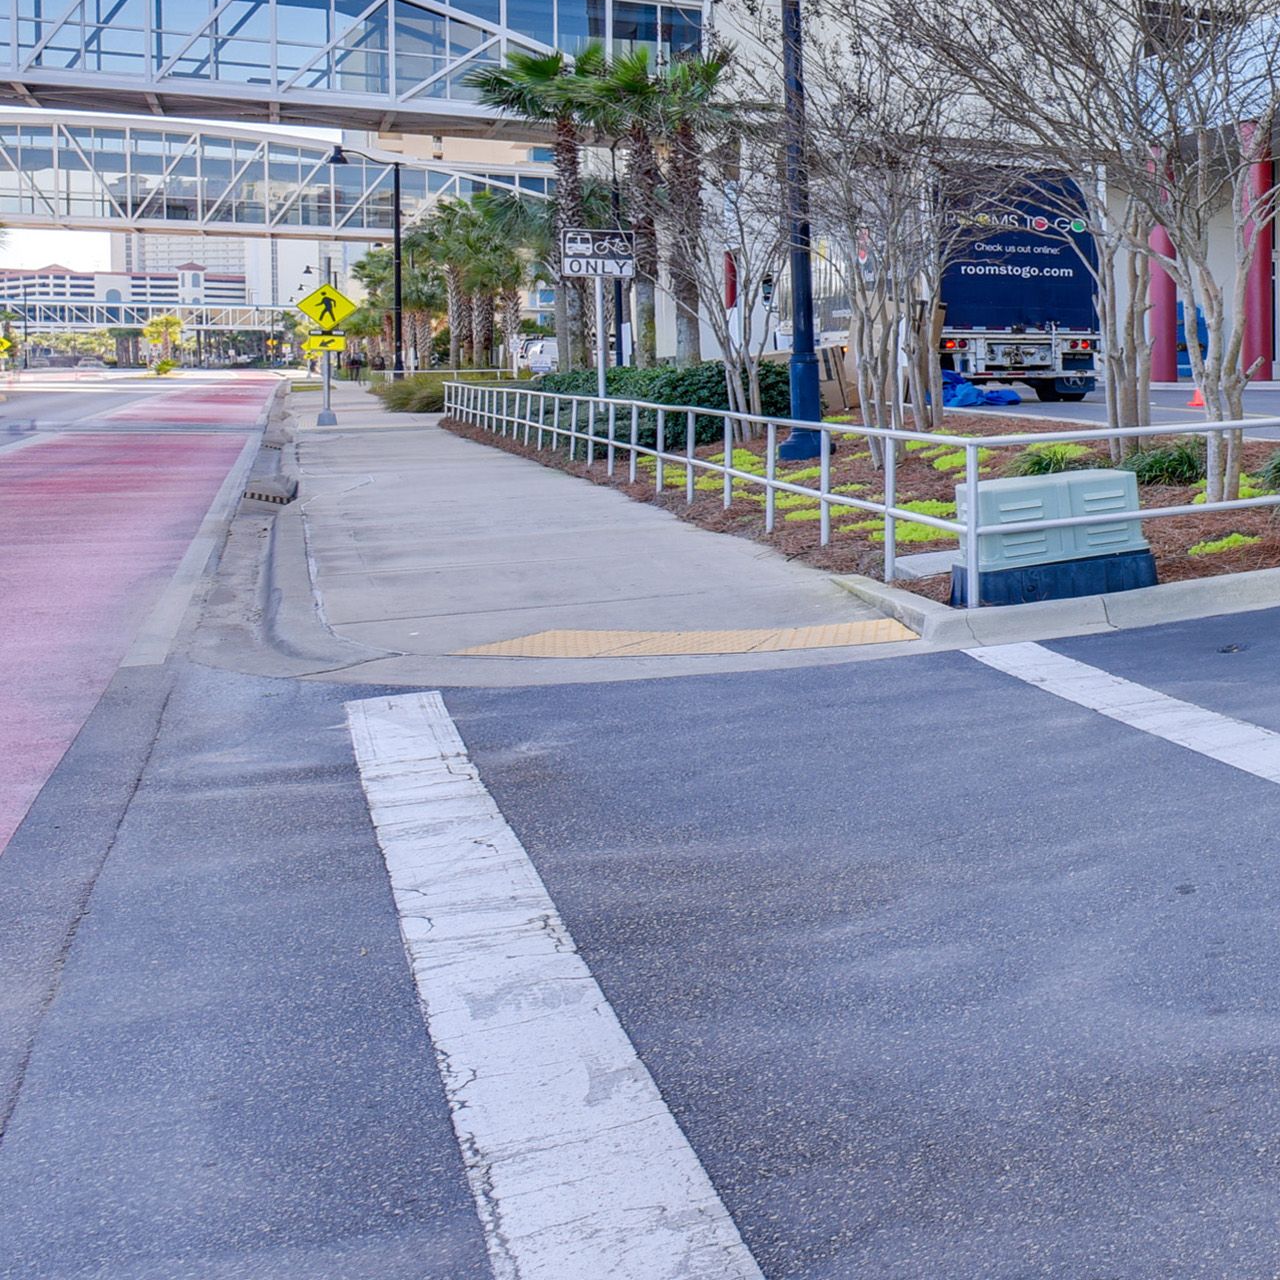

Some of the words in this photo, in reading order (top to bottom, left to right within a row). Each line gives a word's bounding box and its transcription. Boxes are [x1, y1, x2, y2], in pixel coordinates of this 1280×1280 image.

[1024, 214, 1049, 231] TO
[1054, 217, 1087, 233] GO
[974, 242, 1003, 253] Check
[1005, 245, 1016, 253] us
[1017, 244, 1031, 254] out
[569, 259, 628, 274] ONLY
[960, 265, 1074, 279] roomstogo.com
